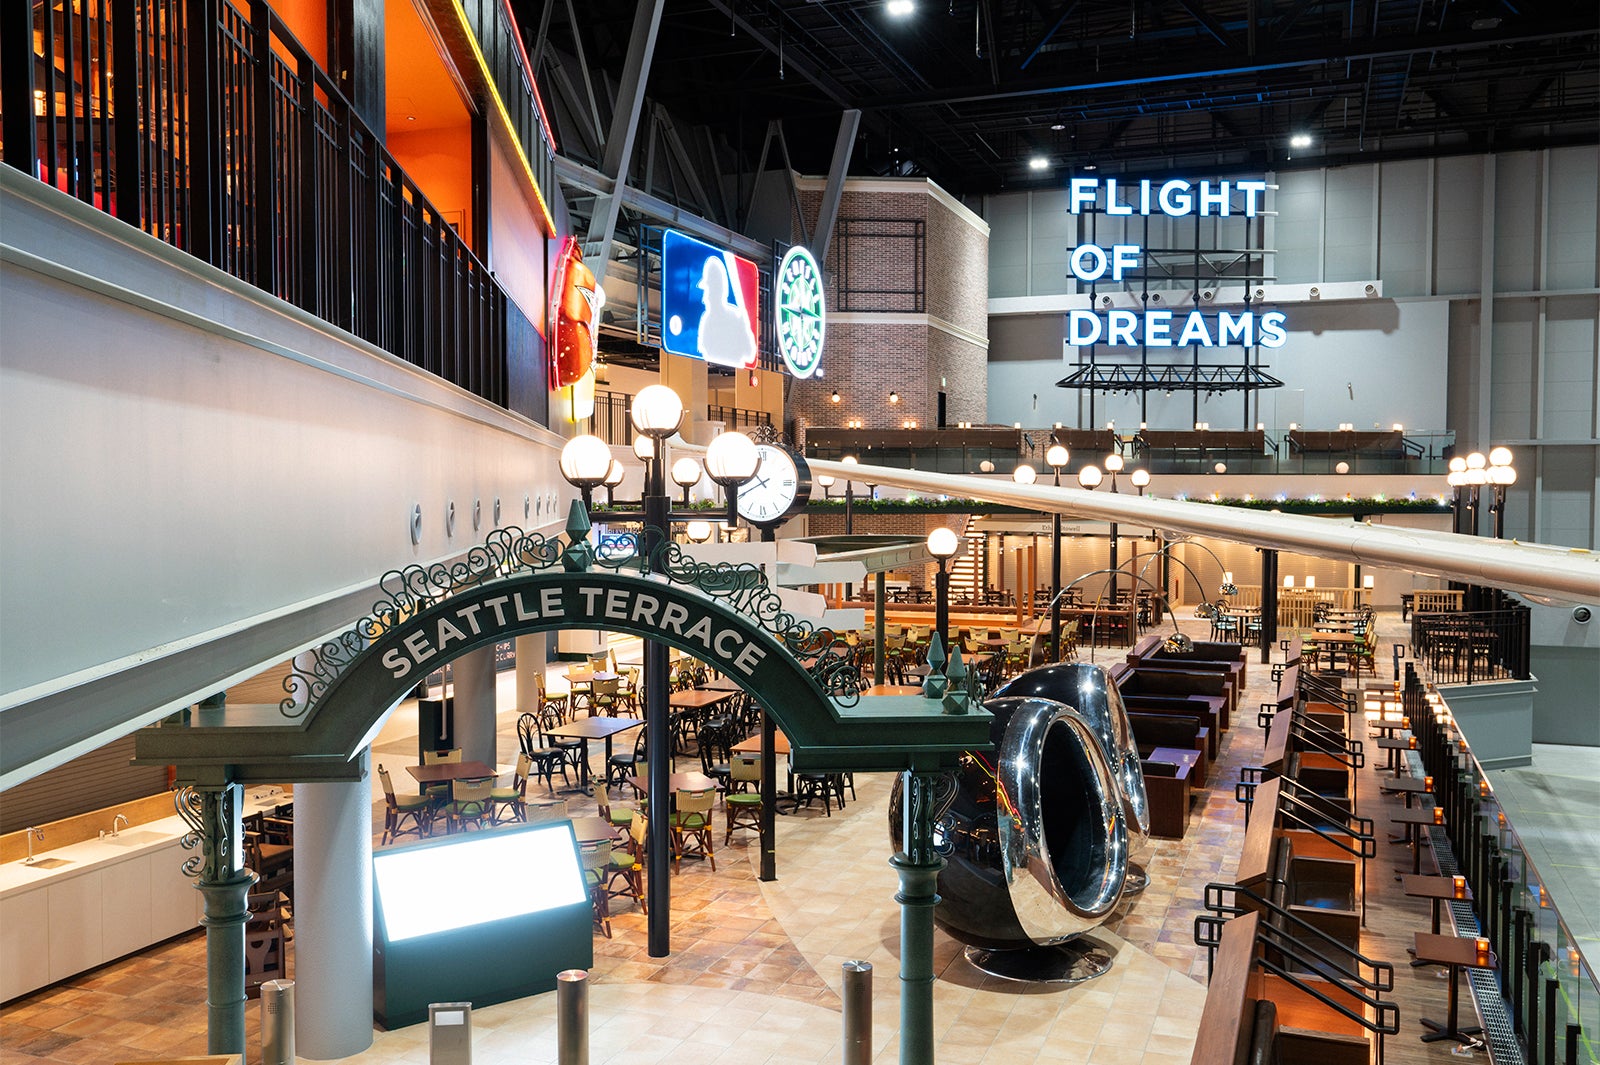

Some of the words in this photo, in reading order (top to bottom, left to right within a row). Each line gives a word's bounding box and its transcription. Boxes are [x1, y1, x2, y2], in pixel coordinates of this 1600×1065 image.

[1069, 178, 1266, 217] FLIGHT
[1069, 243, 1141, 282] OF
[1068, 310, 1288, 348] DREAMS
[381, 587, 565, 680] SEATTLE
[578, 586, 767, 676] TERRACE
